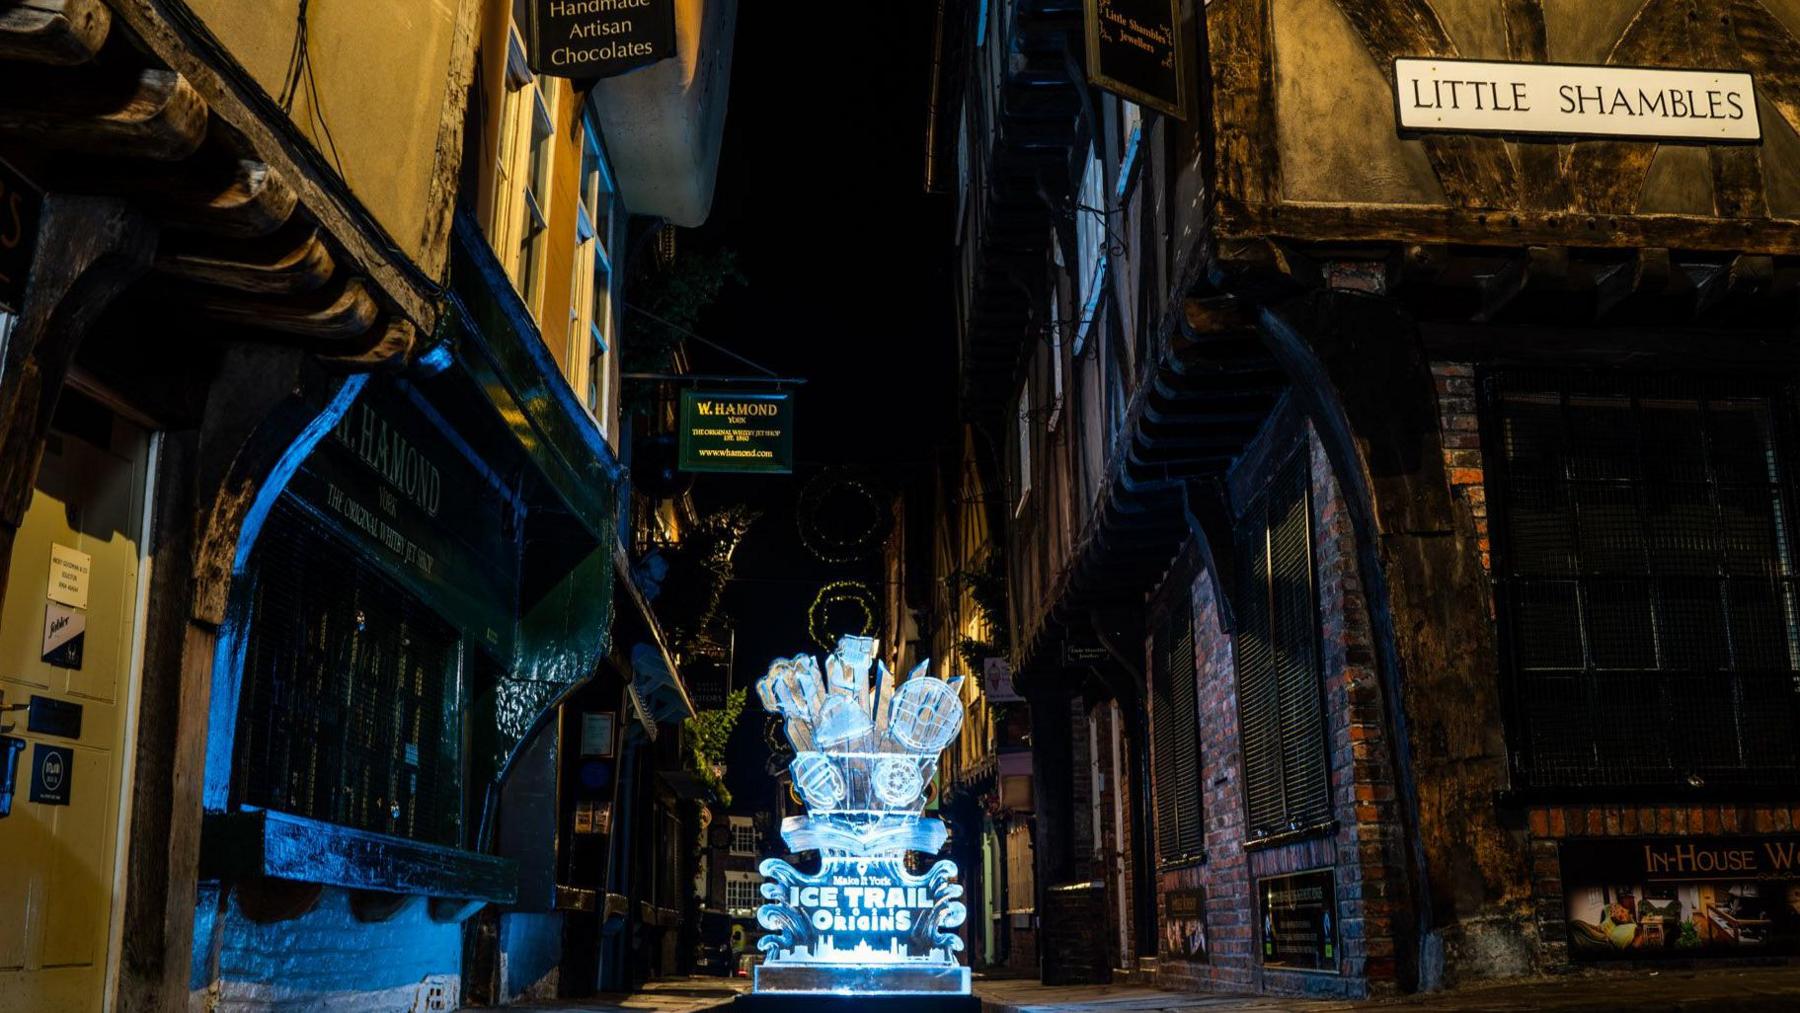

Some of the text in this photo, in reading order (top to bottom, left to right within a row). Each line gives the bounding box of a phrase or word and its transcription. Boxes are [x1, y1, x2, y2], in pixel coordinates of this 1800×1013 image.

[569, 20, 632, 39] Artisan
[551, 41, 653, 66] Chocolates
[1412, 79, 1744, 120] LITTLE SHAMBLES
[697, 401, 778, 416] W. HAMOND
[728, 416, 747, 424] YORK
[692, 428, 704, 436] THE
[359, 401, 440, 518] HAMOND
[699, 448, 773, 457] www.whamond.com
[328, 484, 344, 512] THE
[1763, 842, 1800, 870] W
[833, 876, 859, 886] Make
[868, 876, 891, 886] York
[790, 887, 934, 908] ICE TRAIL
